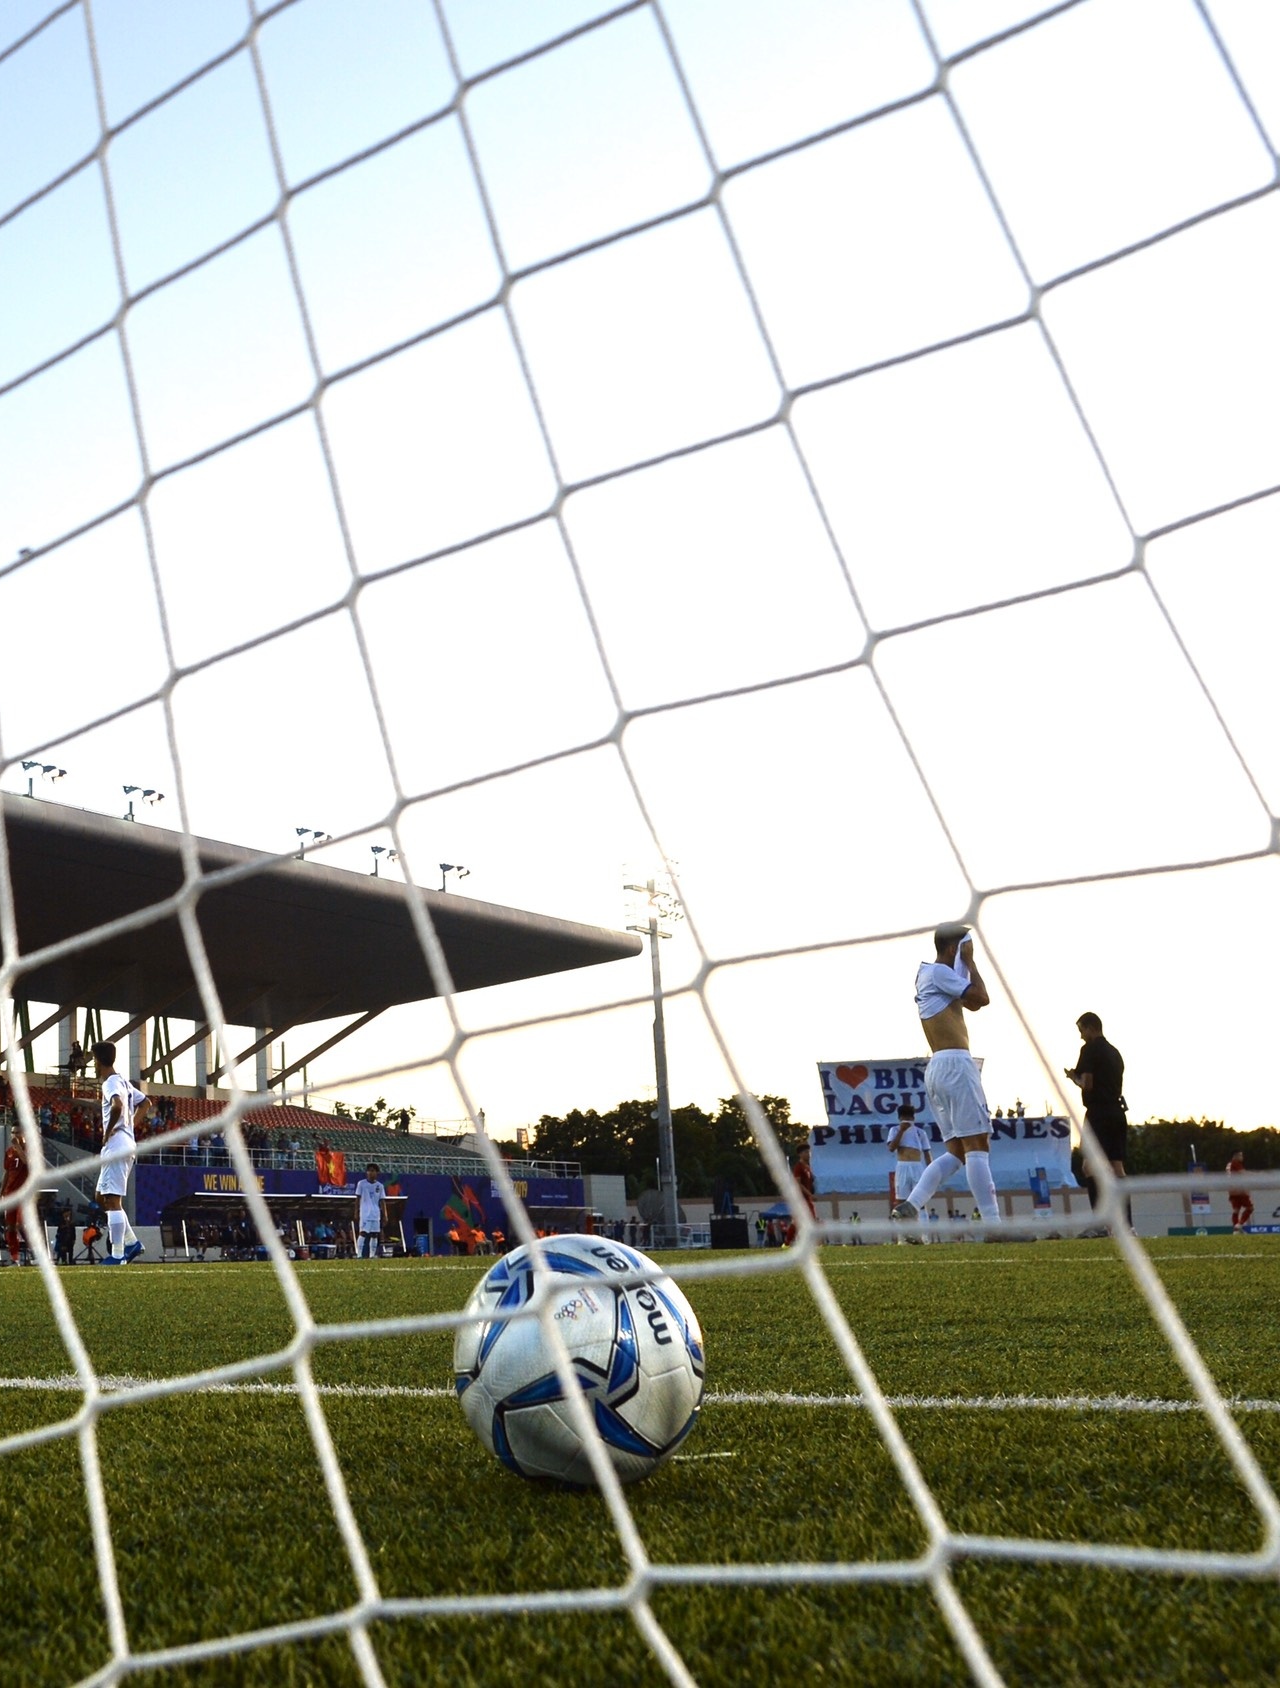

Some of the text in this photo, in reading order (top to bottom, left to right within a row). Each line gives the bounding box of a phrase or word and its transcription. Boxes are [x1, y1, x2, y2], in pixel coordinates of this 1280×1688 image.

[820, 1062, 926, 1091] I BIÑ
[825, 1092, 926, 1115] LAGU
[813, 1118, 1071, 1146] PHINES
[203, 1174, 218, 1191] WE
[219, 1174, 237, 1191] WIN
[591, 1246, 673, 1346] molen
